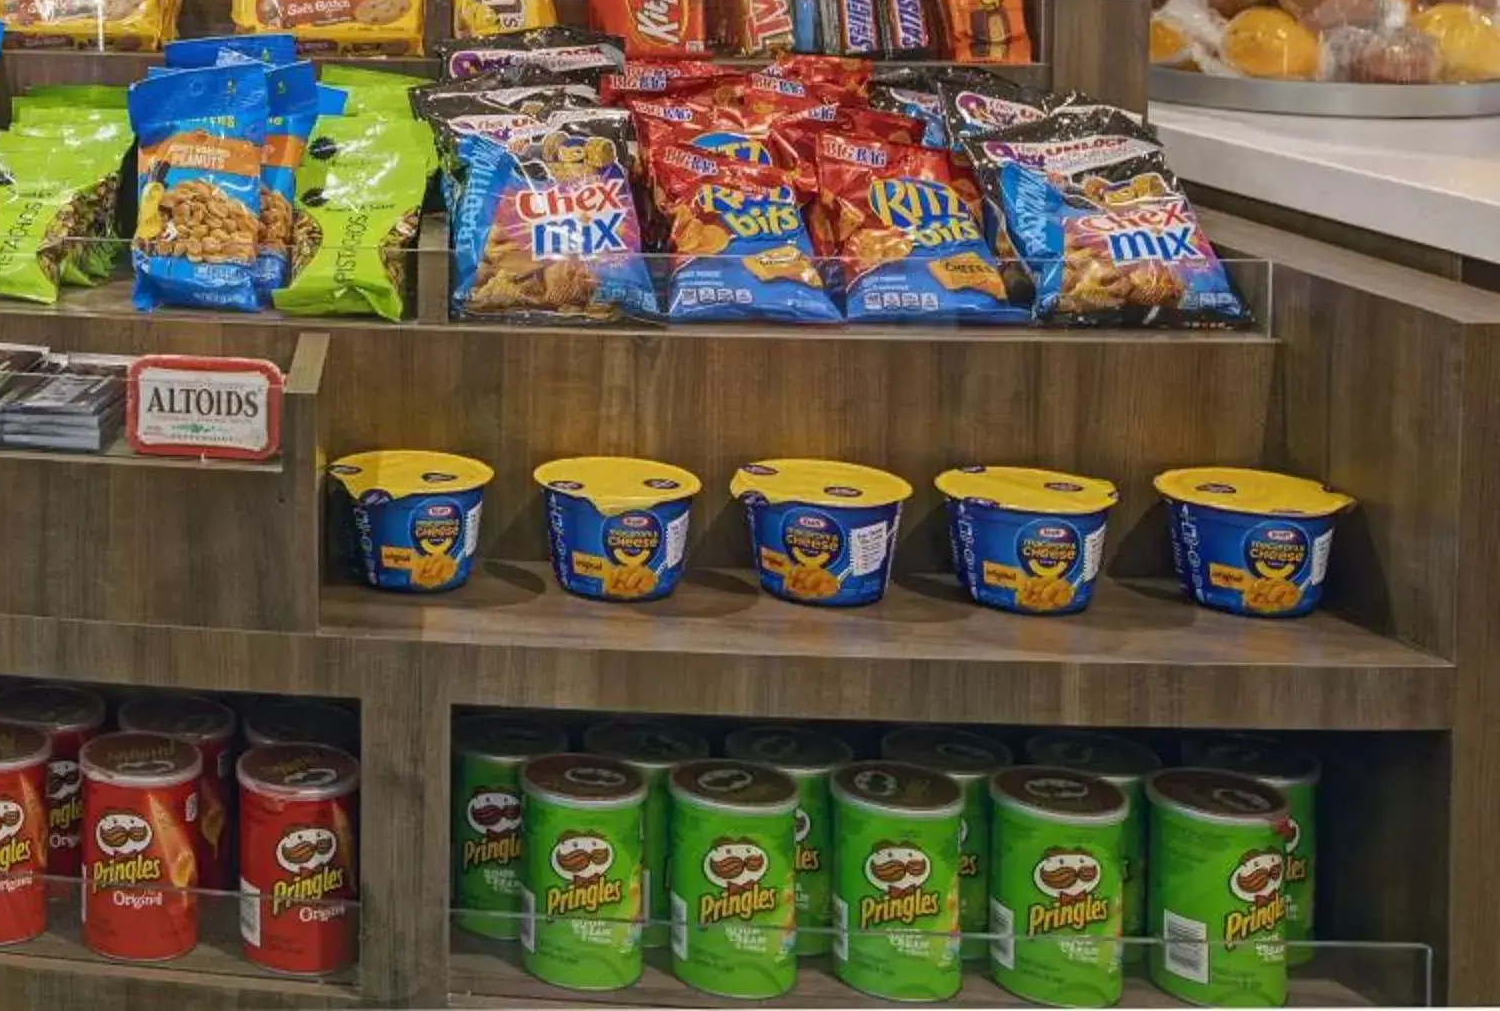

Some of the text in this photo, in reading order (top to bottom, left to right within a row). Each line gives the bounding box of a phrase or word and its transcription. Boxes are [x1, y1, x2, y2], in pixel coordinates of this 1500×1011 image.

[822, 138, 888, 169] BIG BAG
[516, 178, 625, 220] Chex
[871, 178, 969, 228] RITZ
[724, 204, 800, 238] bits
[911, 217, 980, 247] bits
[1076, 201, 1187, 236] Chex
[147, 386, 259, 419] ALTOIDS
[463, 839, 520, 870] Pringl
[93, 855, 161, 893] Pringles
[273, 867, 343, 915] Pringles
[112, 890, 163, 909] Original
[299, 905, 345, 922] Original
[546, 876, 622, 920] Pringles
[700, 887, 777, 927] Pringles
[860, 888, 940, 929] Pringles
[1028, 894, 1109, 938] Pringles
[1225, 895, 1285, 951] Pringl
